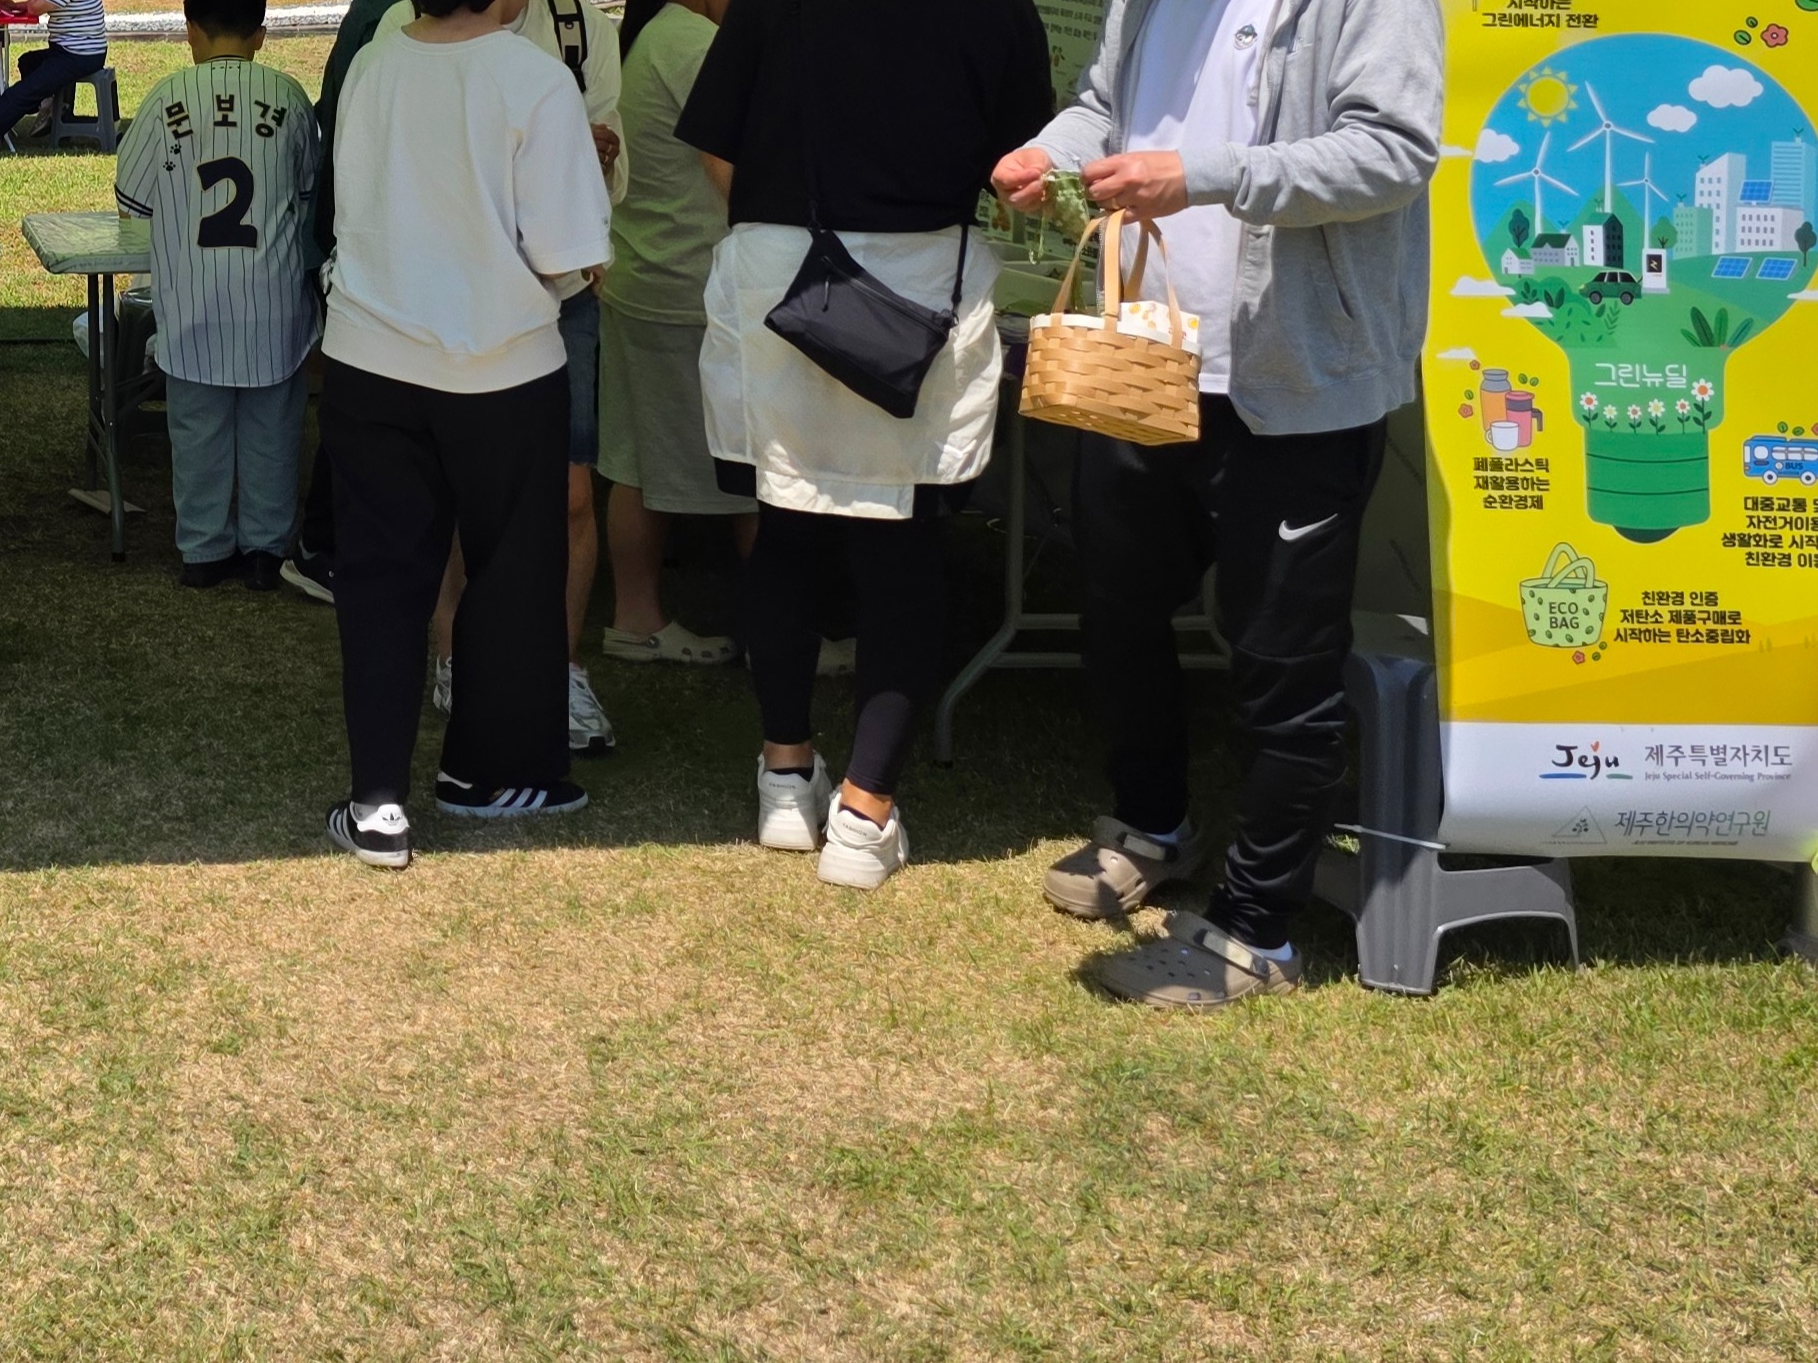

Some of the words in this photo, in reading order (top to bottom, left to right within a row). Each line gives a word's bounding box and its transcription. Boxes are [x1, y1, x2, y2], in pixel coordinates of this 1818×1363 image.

[1481, 12, 1561, 29] 그린에너지
[1565, 12, 1599, 29] 전환
[165, 94, 288, 140] 문보경
[196, 156, 258, 249] 2
[1594, 363, 1688, 389] 그린뉴딜
[1472, 456, 1551, 474] 폐플라스틱
[1784, 461, 1804, 470] BUS
[1474, 474, 1551, 493] 재활용하는
[1483, 493, 1544, 511] 순환경제
[1743, 496, 1807, 513] 대중교통
[1722, 533, 1784, 549] 생활화로
[1745, 551, 1792, 567] 친환경
[1641, 590, 1684, 607] 친환경
[1689, 590, 1719, 607] 인증
[1548, 600, 1579, 616] ECO
[1620, 608, 1664, 626] 저탄소
[1668, 609, 1743, 626] 제품구매로
[1548, 616, 1580, 632] BAG
[1613, 627, 1672, 645] 시작하는
[1675, 627, 1751, 645] 탄소중립화
[1551, 741, 1620, 780] Jeju
[1644, 743, 1794, 768] 제주특별자치도
[1644, 772, 1661, 781] Jeju
[1662, 772, 1693, 782] Special
[1694, 771, 1755, 783] Self-Governing
[1757, 772, 1792, 781] Province
[1614, 810, 1772, 838] 제주한의약연구원
